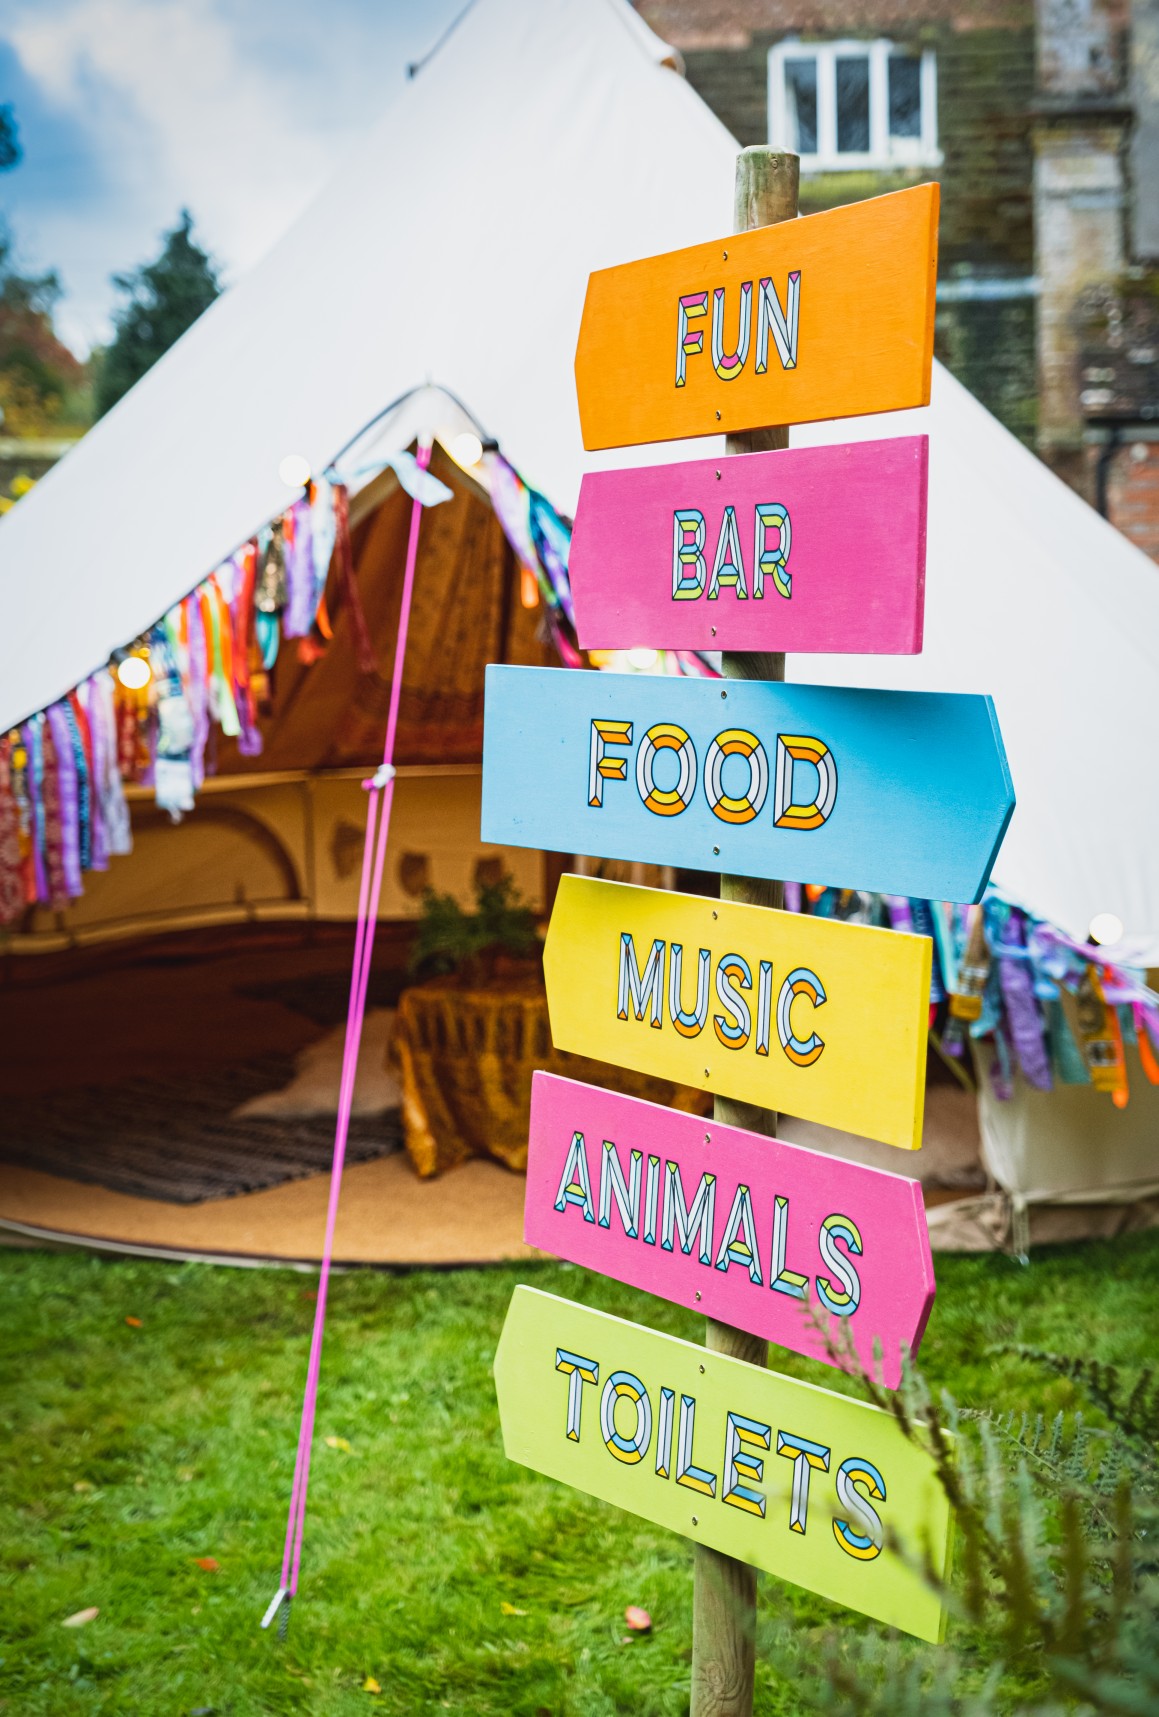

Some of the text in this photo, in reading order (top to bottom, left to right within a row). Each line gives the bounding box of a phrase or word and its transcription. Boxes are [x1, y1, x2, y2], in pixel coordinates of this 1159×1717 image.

[675, 270, 801, 388] FUN
[672, 503, 792, 601] BAR
[588, 719, 838, 831] FOOD
[617, 932, 827, 1068] MUSIC
[553, 1131, 863, 1317] ANIMALS
[555, 1348, 887, 1561] TOILETS
